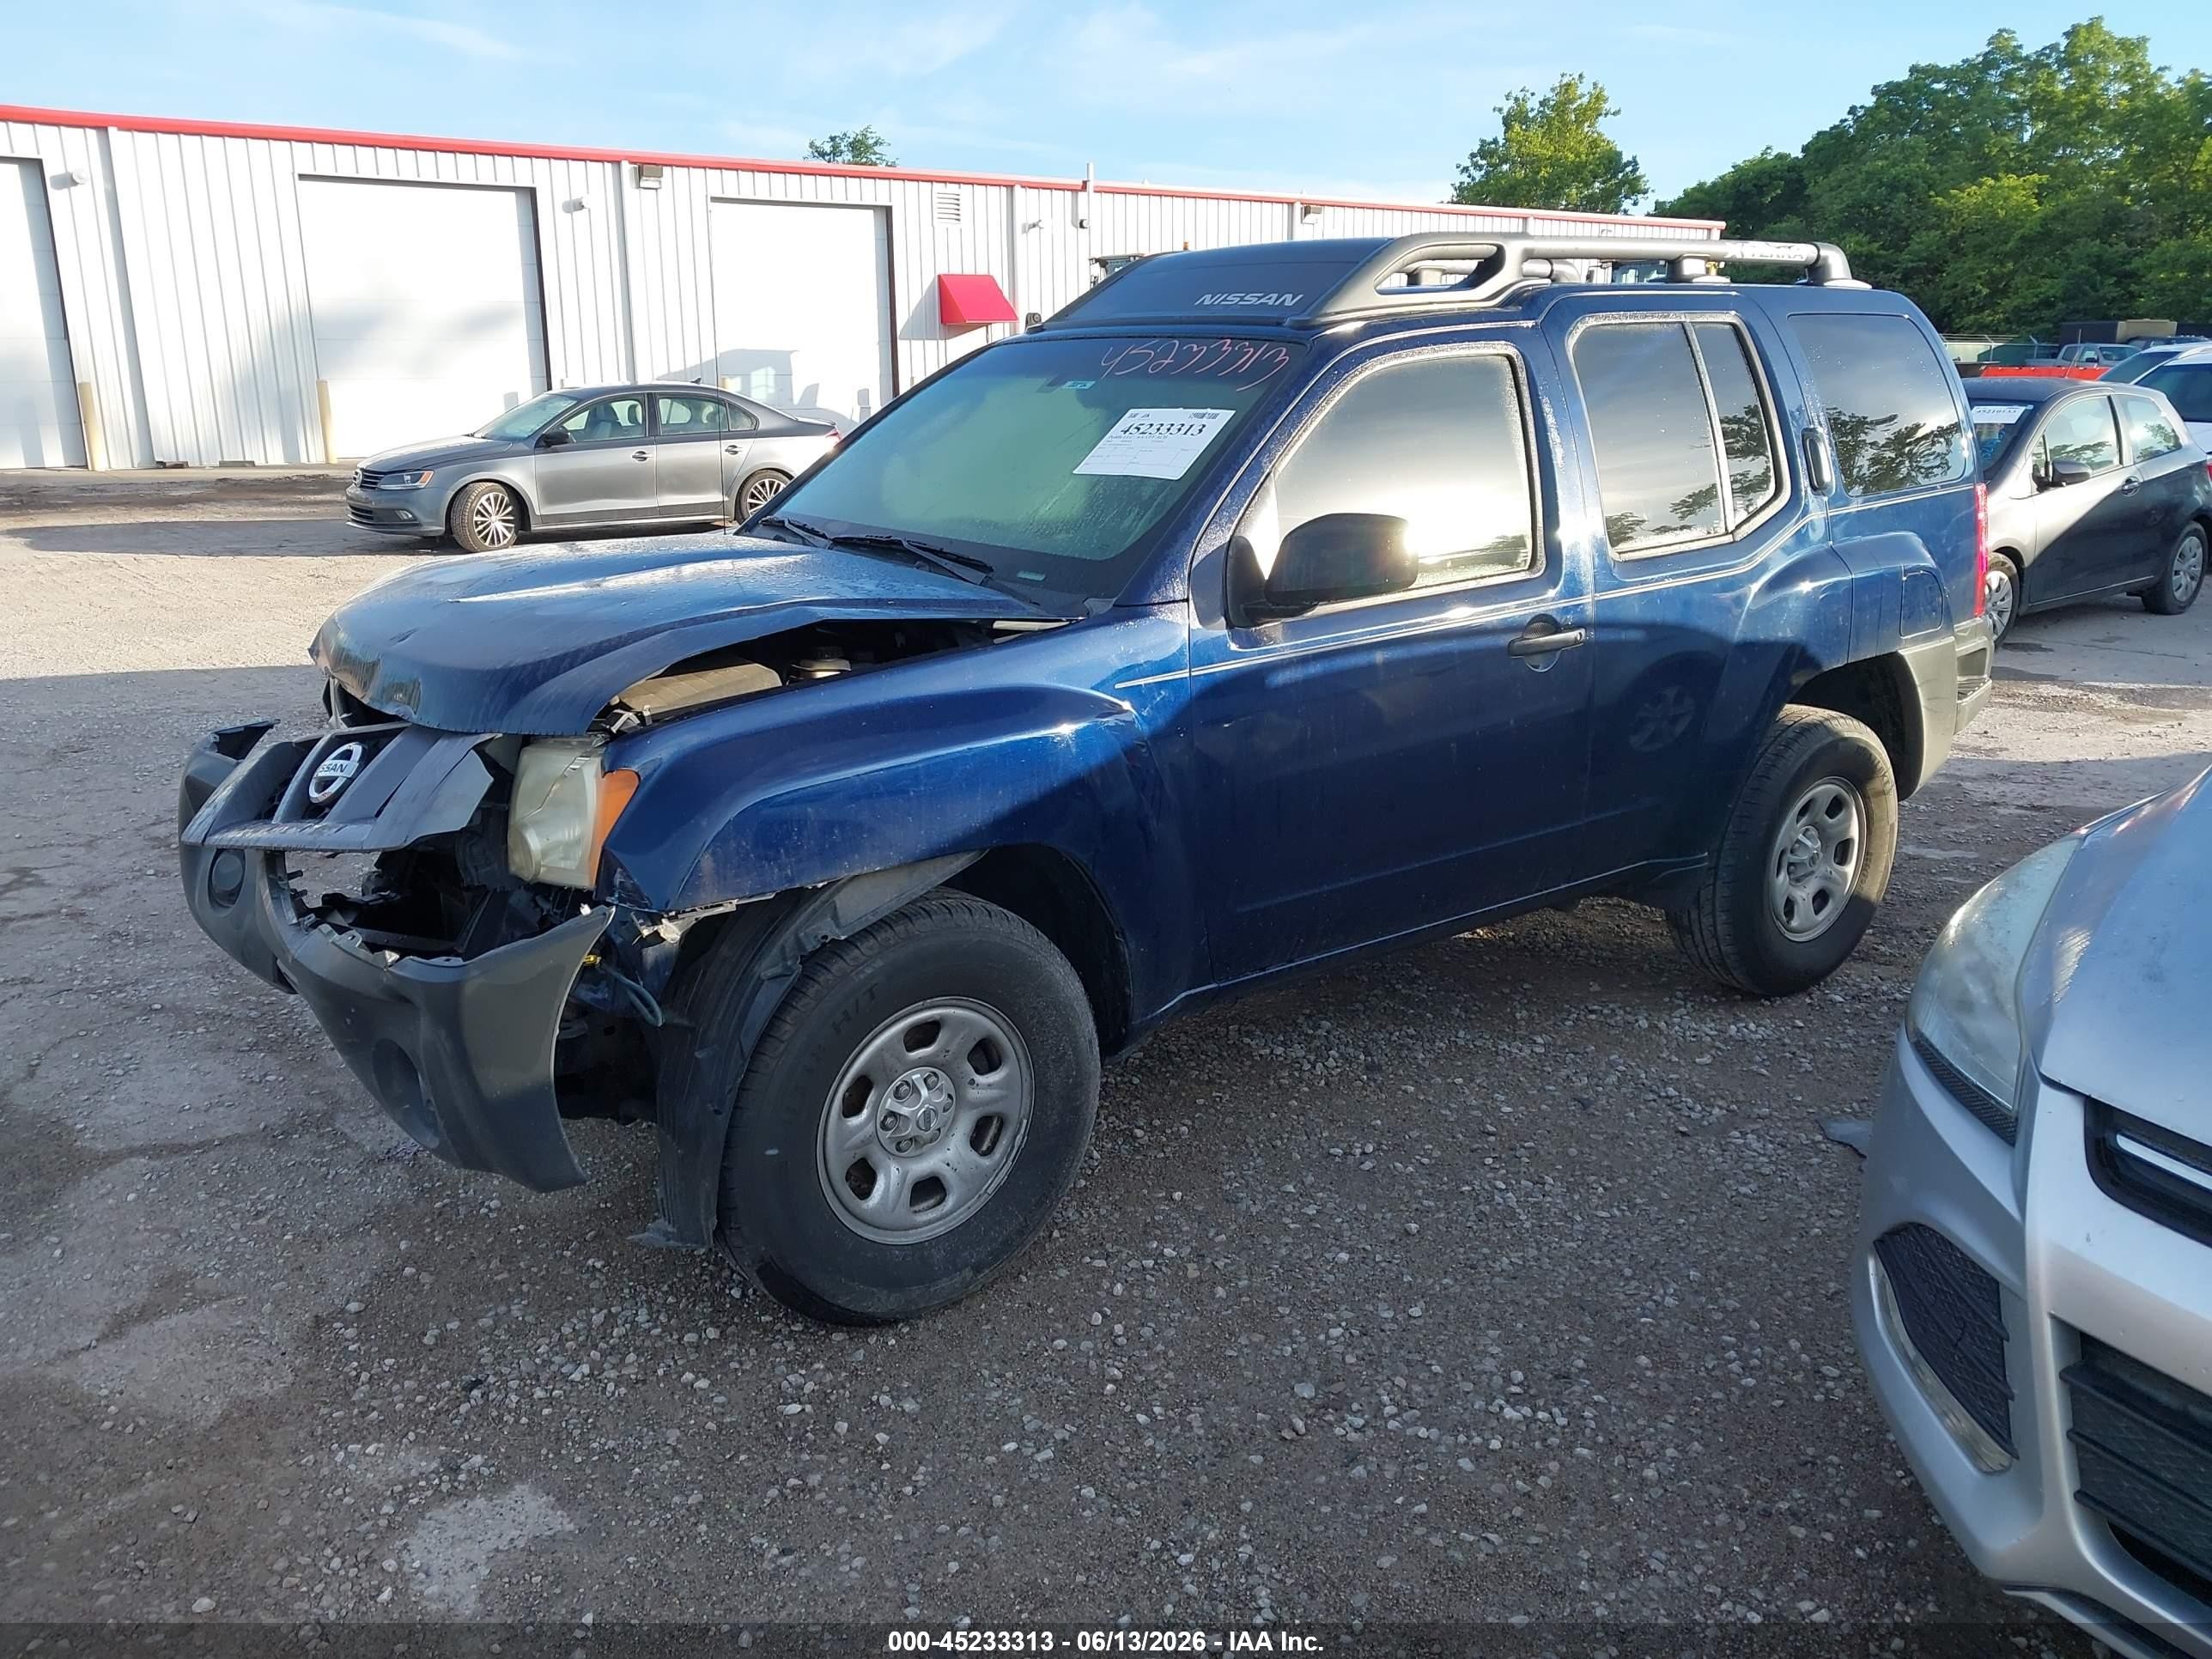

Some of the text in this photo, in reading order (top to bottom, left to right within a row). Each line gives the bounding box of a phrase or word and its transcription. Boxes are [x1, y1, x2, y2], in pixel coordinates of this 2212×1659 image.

[1194, 293, 1304, 307] NISSAN
[1101, 338, 1290, 392] 45233313
[1120, 422, 1207, 437] 45233313
[319, 763, 349, 774] SSAN
